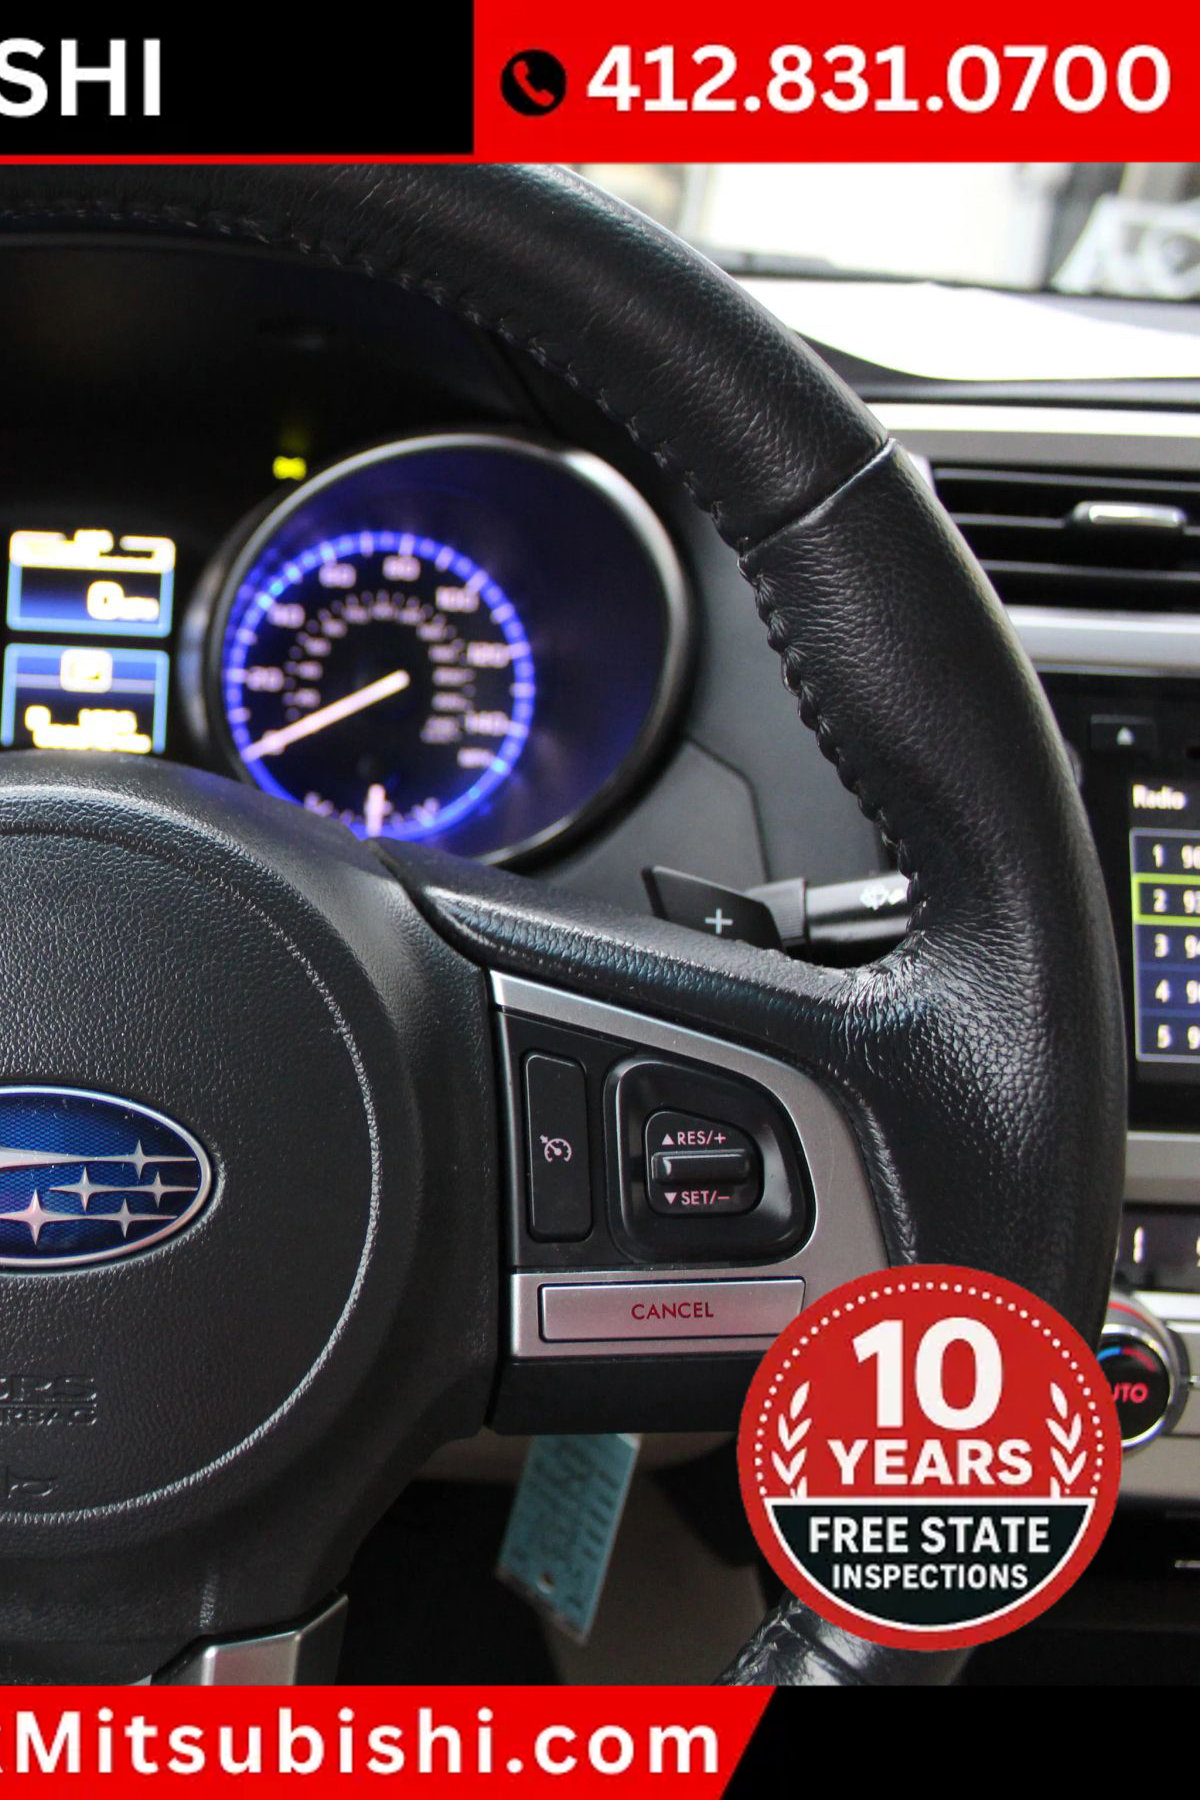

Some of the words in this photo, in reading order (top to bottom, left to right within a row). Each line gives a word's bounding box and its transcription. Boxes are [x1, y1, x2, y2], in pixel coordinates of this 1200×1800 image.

[1133, 784, 1187, 810] Radio
[1152, 844, 1164, 868] 1
[1153, 888, 1167, 913] 2
[1154, 933, 1169, 958] 3
[1155, 979, 1170, 1003] 4
[1157, 1024, 1171, 1049] 5
[631, 1301, 714, 1320] CANCEL
